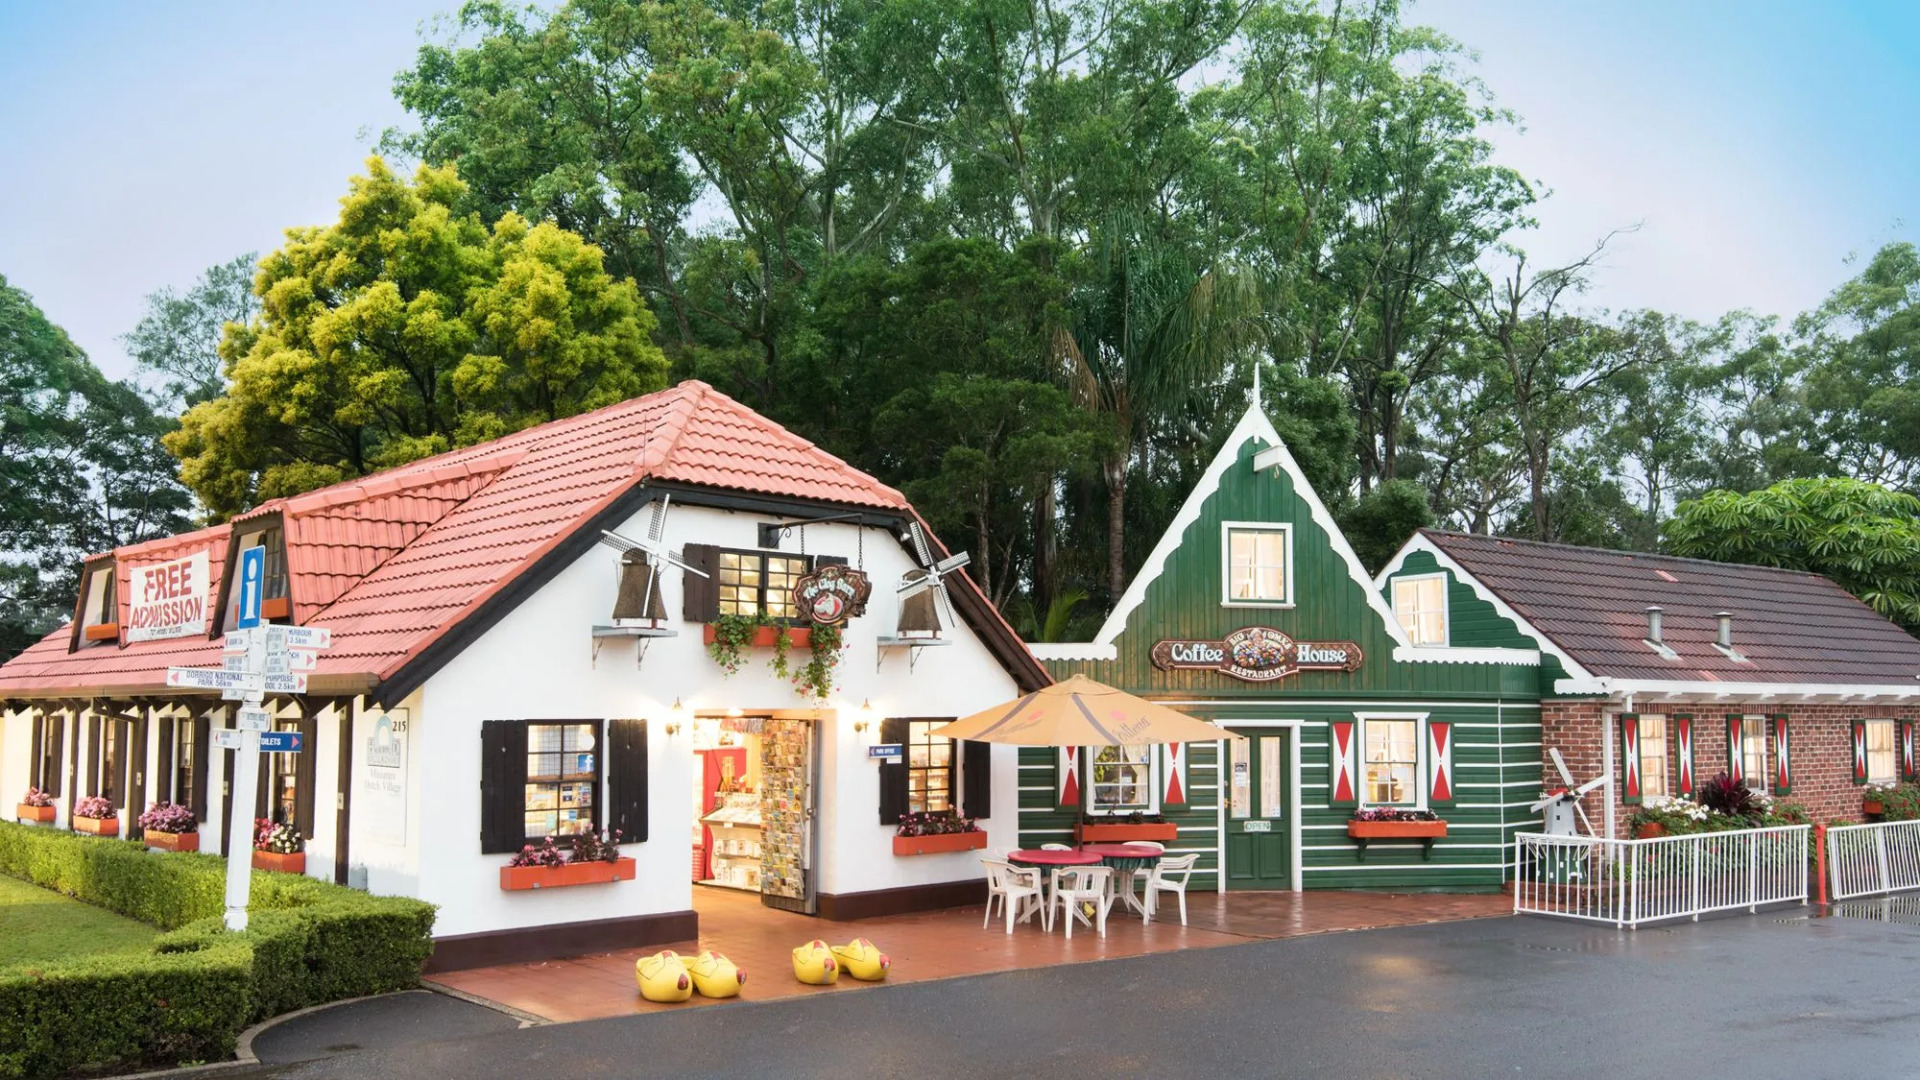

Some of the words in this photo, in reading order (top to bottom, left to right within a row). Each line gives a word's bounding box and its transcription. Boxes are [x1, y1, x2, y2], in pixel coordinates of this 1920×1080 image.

[144, 561, 192, 602] FREE
[129, 596, 203, 629] ADMISSION
[1229, 632, 1245, 646] BIG
[1171, 643, 1223, 662] Coffee
[1296, 644, 1346, 663] House
[185, 670, 213, 680] DORRIGO
[214, 672, 243, 682] NATIONAL
[1231, 664, 1287, 679] RESTAURANT
[392, 721, 406, 732] 215
[1245, 822, 1270, 831] OPEN
